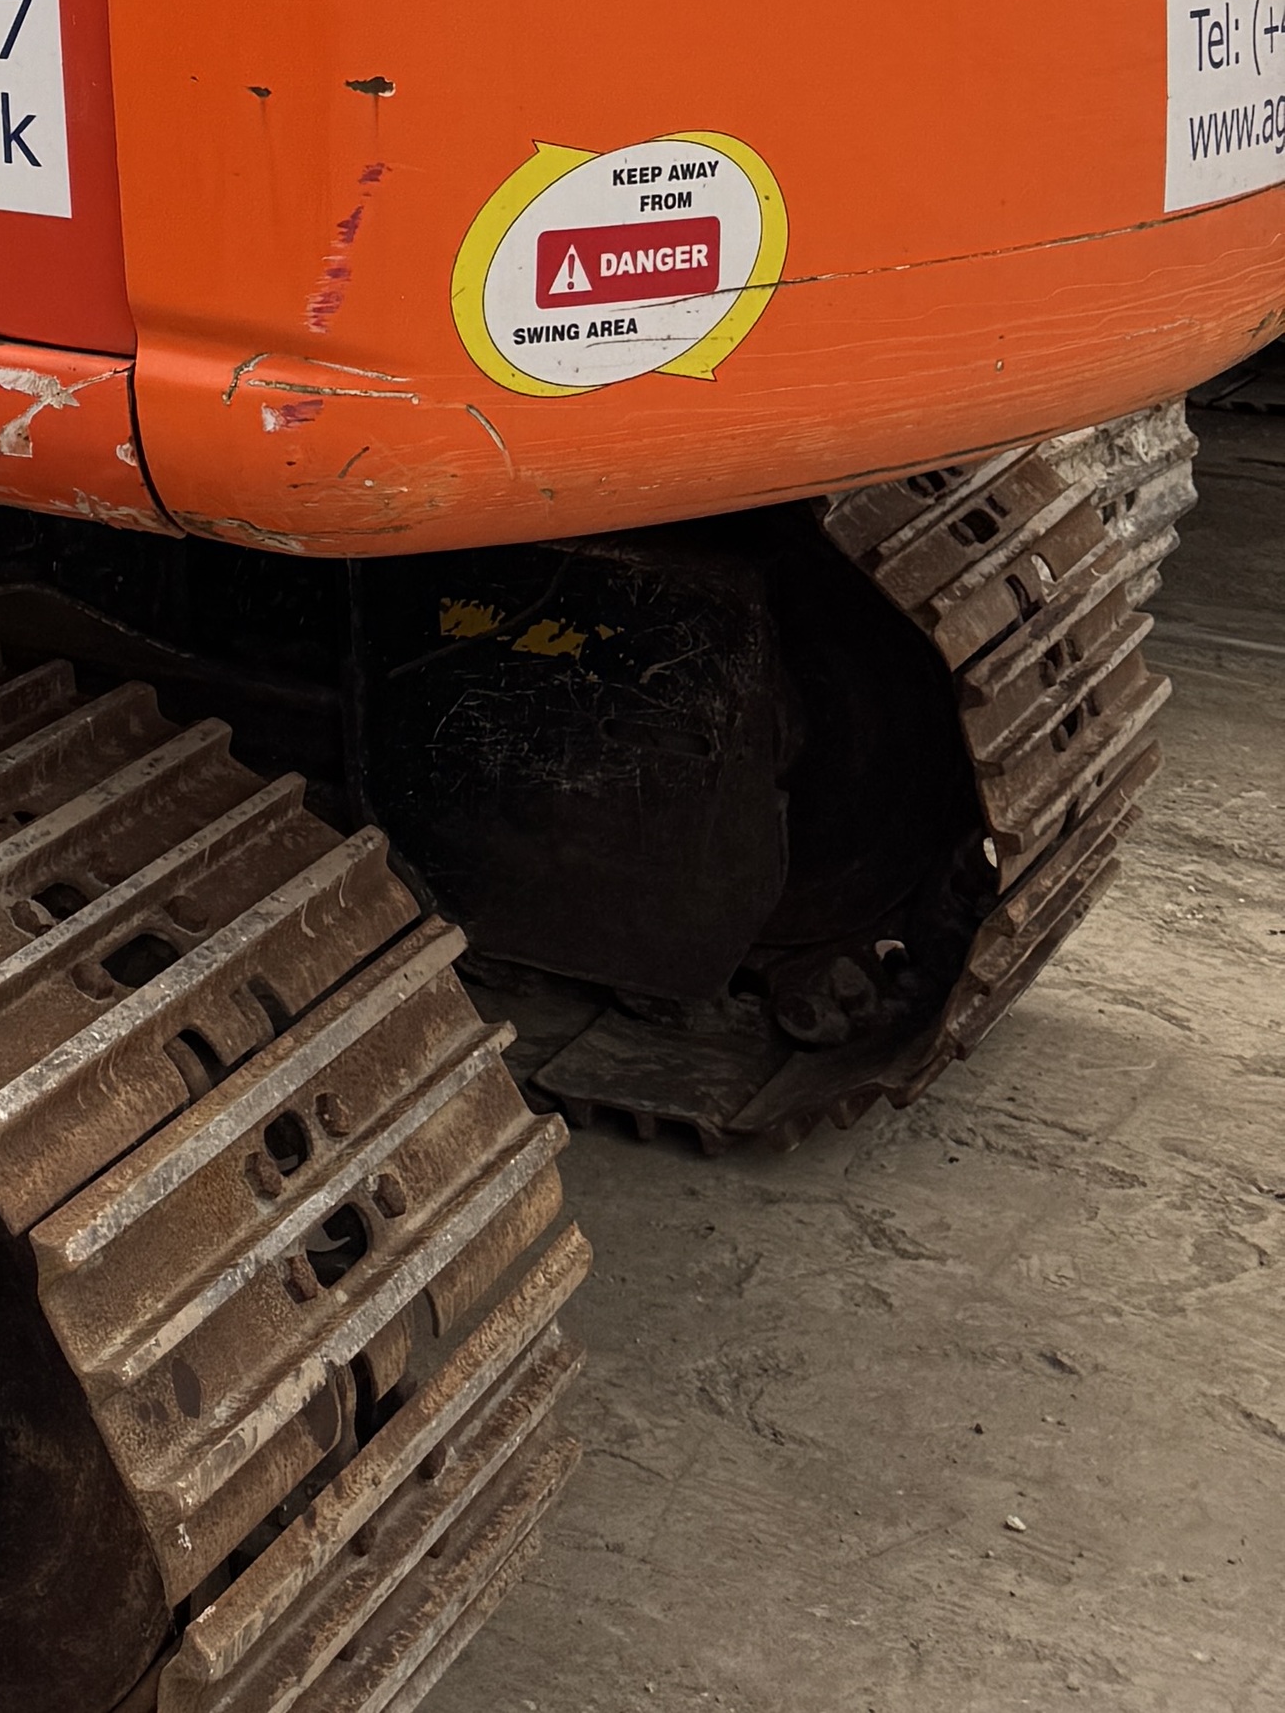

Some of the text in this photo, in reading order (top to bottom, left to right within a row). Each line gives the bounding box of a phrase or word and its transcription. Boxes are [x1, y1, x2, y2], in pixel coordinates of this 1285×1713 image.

[1189, 2, 1239, 72] Tel:
[612, 160, 720, 186] KEEP AWAY
[639, 191, 692, 213] FROM
[599, 244, 709, 278] DANGER
[512, 317, 638, 346] SWING AREA
